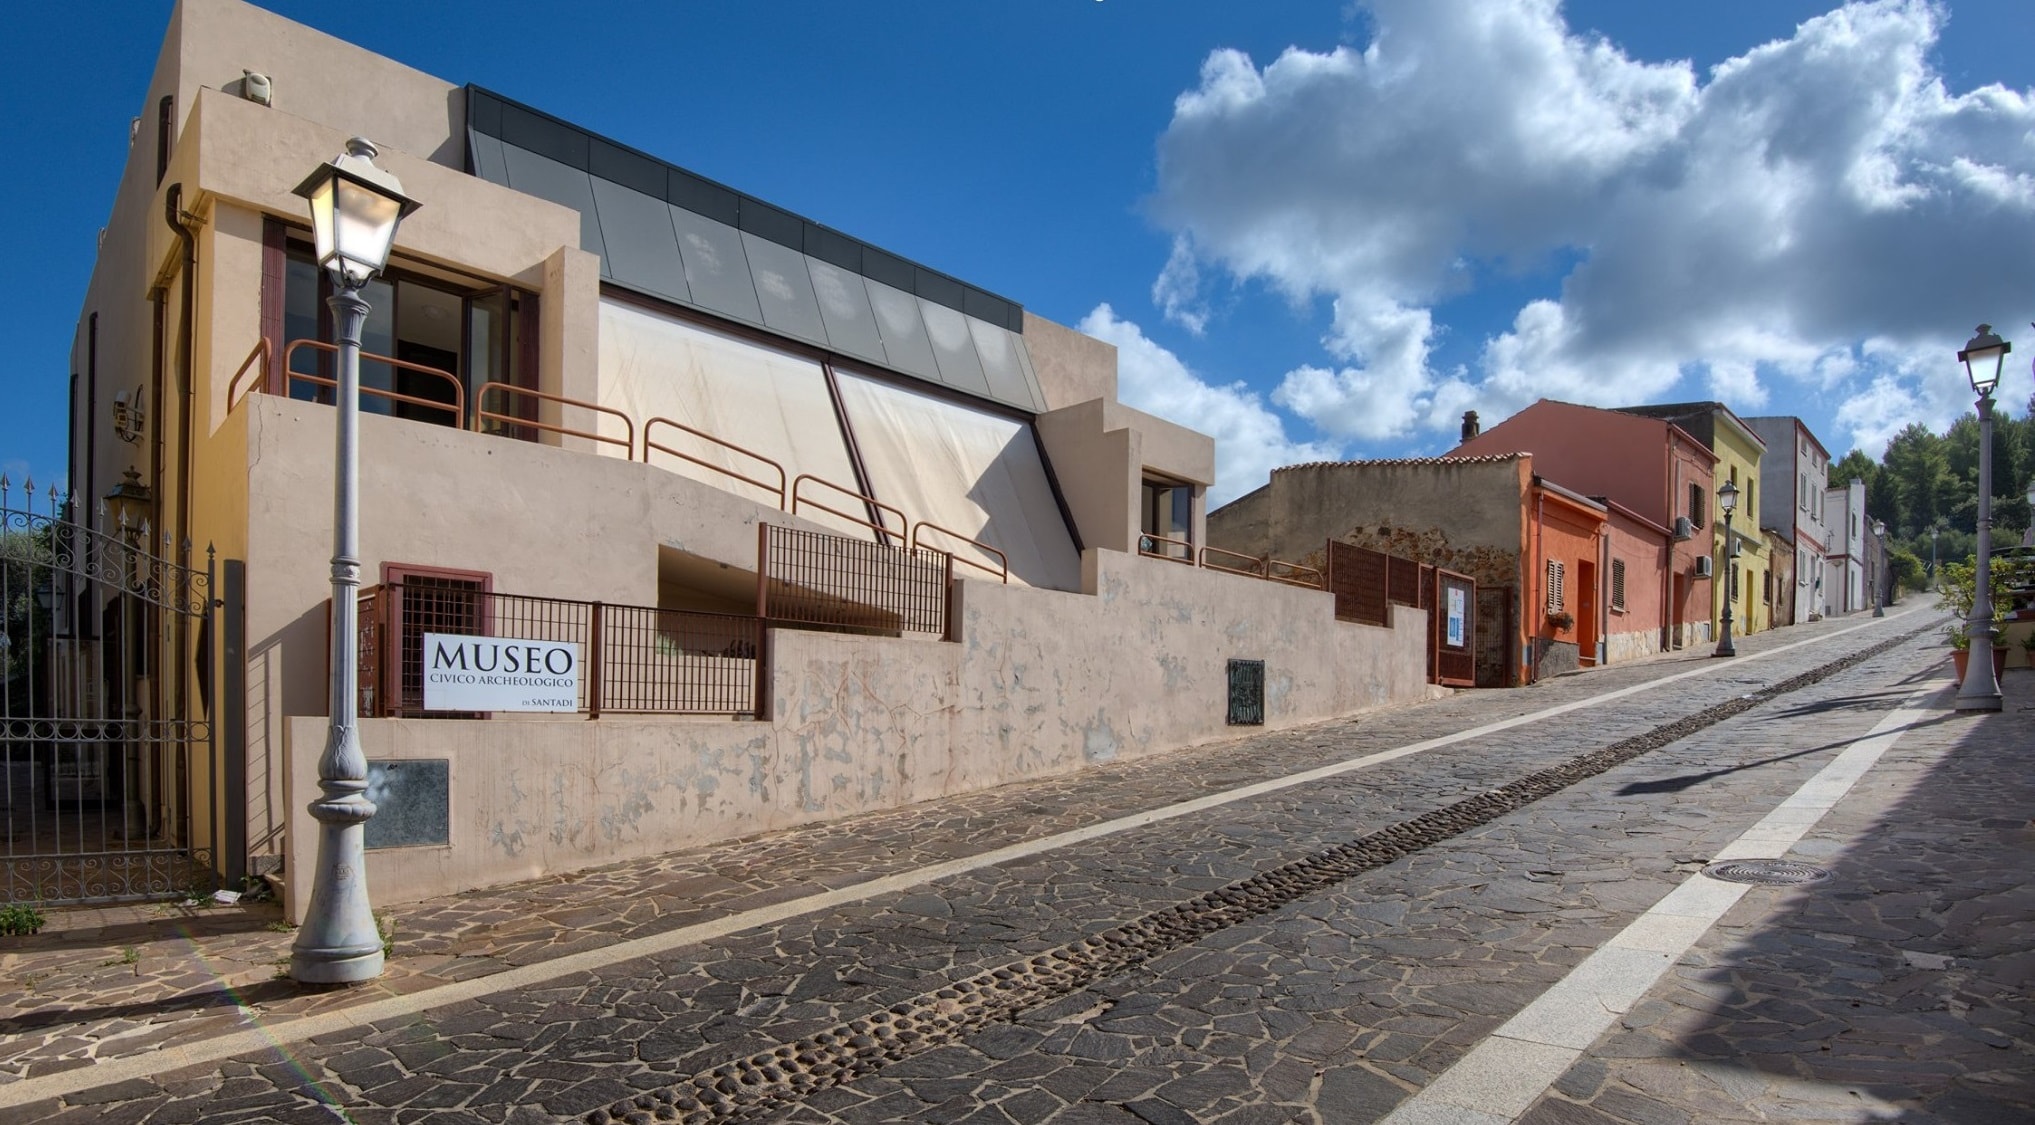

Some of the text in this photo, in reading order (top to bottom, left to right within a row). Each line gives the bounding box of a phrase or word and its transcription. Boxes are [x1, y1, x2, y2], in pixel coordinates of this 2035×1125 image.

[432, 641, 573, 675] MUSEO
[430, 673, 573, 688] CIVICO ARCHEOLOGICO
[532, 698, 573, 707] SANTADI
